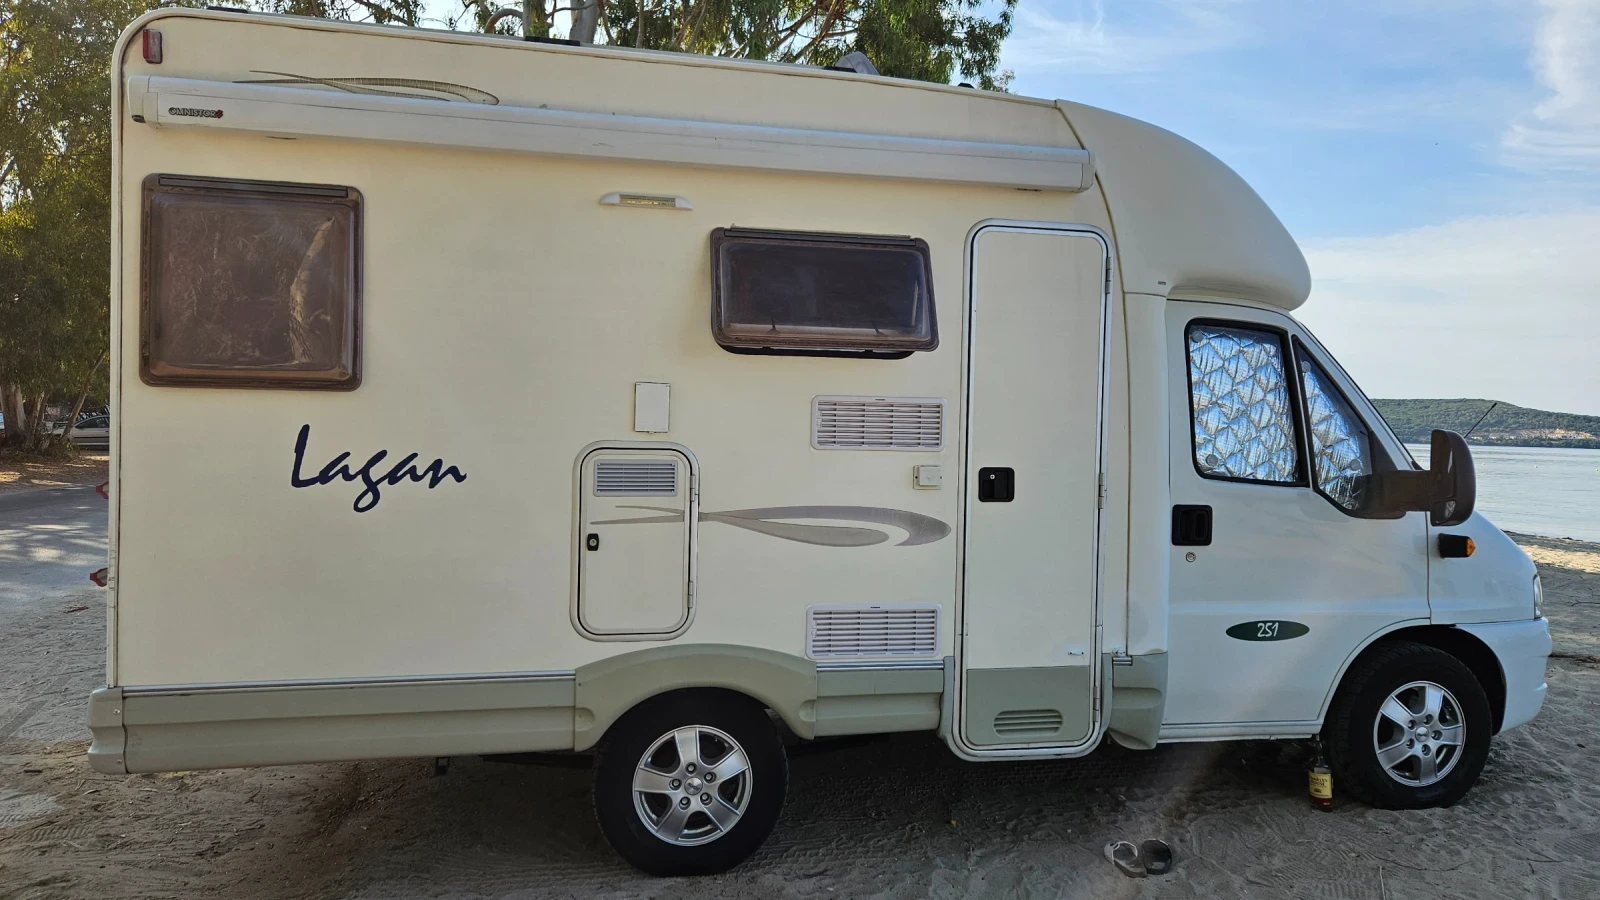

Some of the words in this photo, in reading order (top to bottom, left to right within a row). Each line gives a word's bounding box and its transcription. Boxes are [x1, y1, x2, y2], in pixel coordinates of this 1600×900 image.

[168, 107, 217, 118] OMNISTOR
[291, 423, 468, 513] Lagan
[1257, 622, 1279, 638] 251
